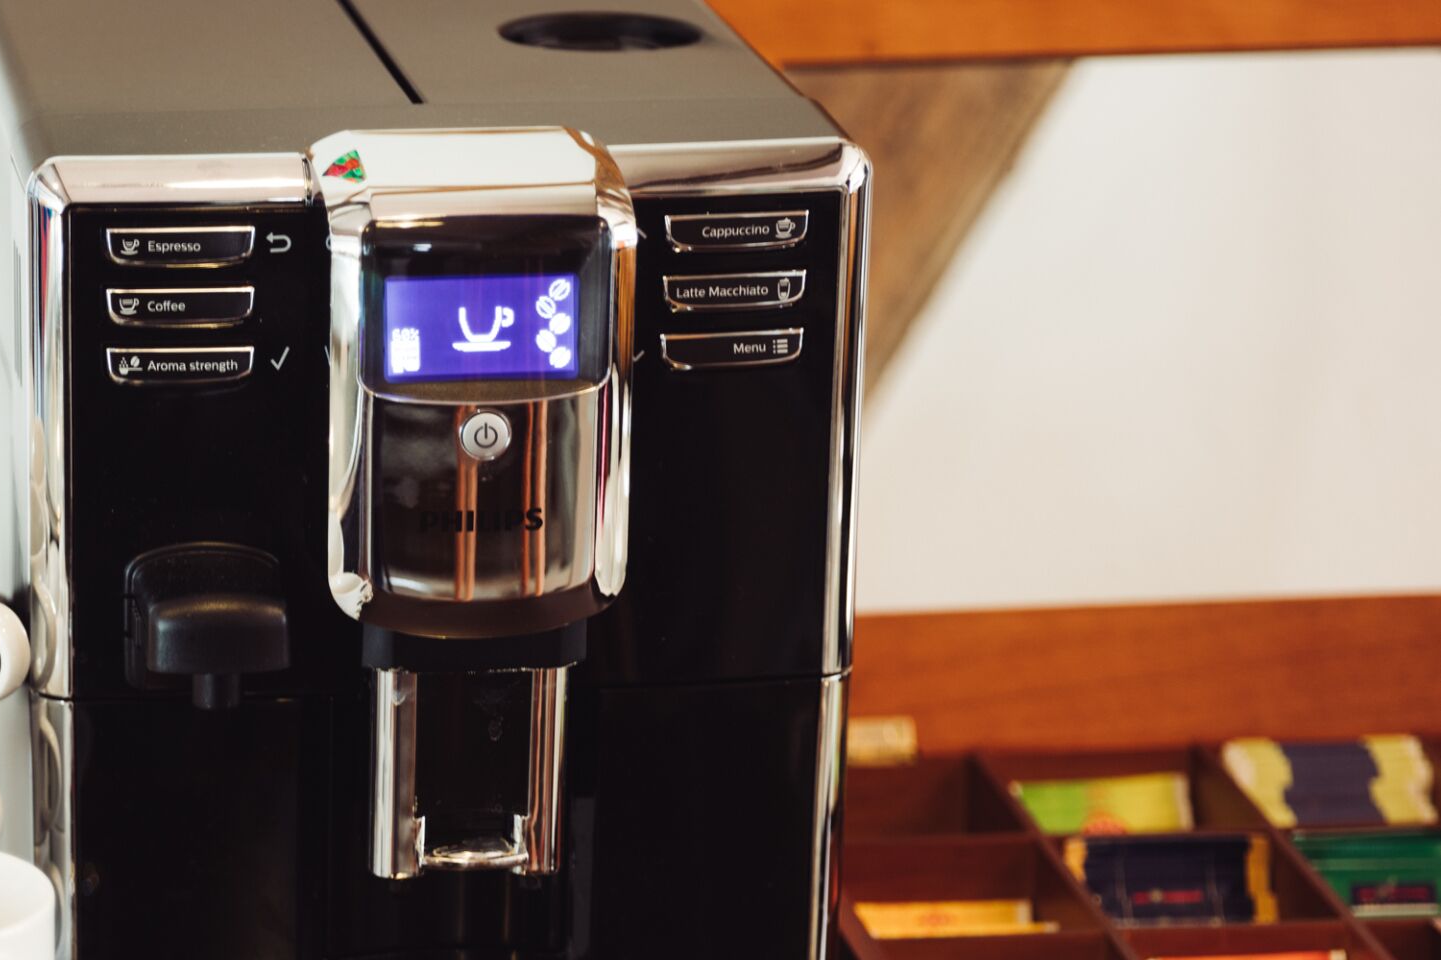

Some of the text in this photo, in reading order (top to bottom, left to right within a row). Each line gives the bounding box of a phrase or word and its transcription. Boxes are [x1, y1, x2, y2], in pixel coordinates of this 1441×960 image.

[702, 225, 770, 239] Cappuccino
[147, 240, 201, 254] Espresso
[676, 284, 769, 299] Latte Macchiato
[147, 300, 186, 312] Coffee
[733, 342, 767, 354] Menu
[147, 359, 239, 373] Aroma strength
[420, 508, 543, 532] PHILIPS
